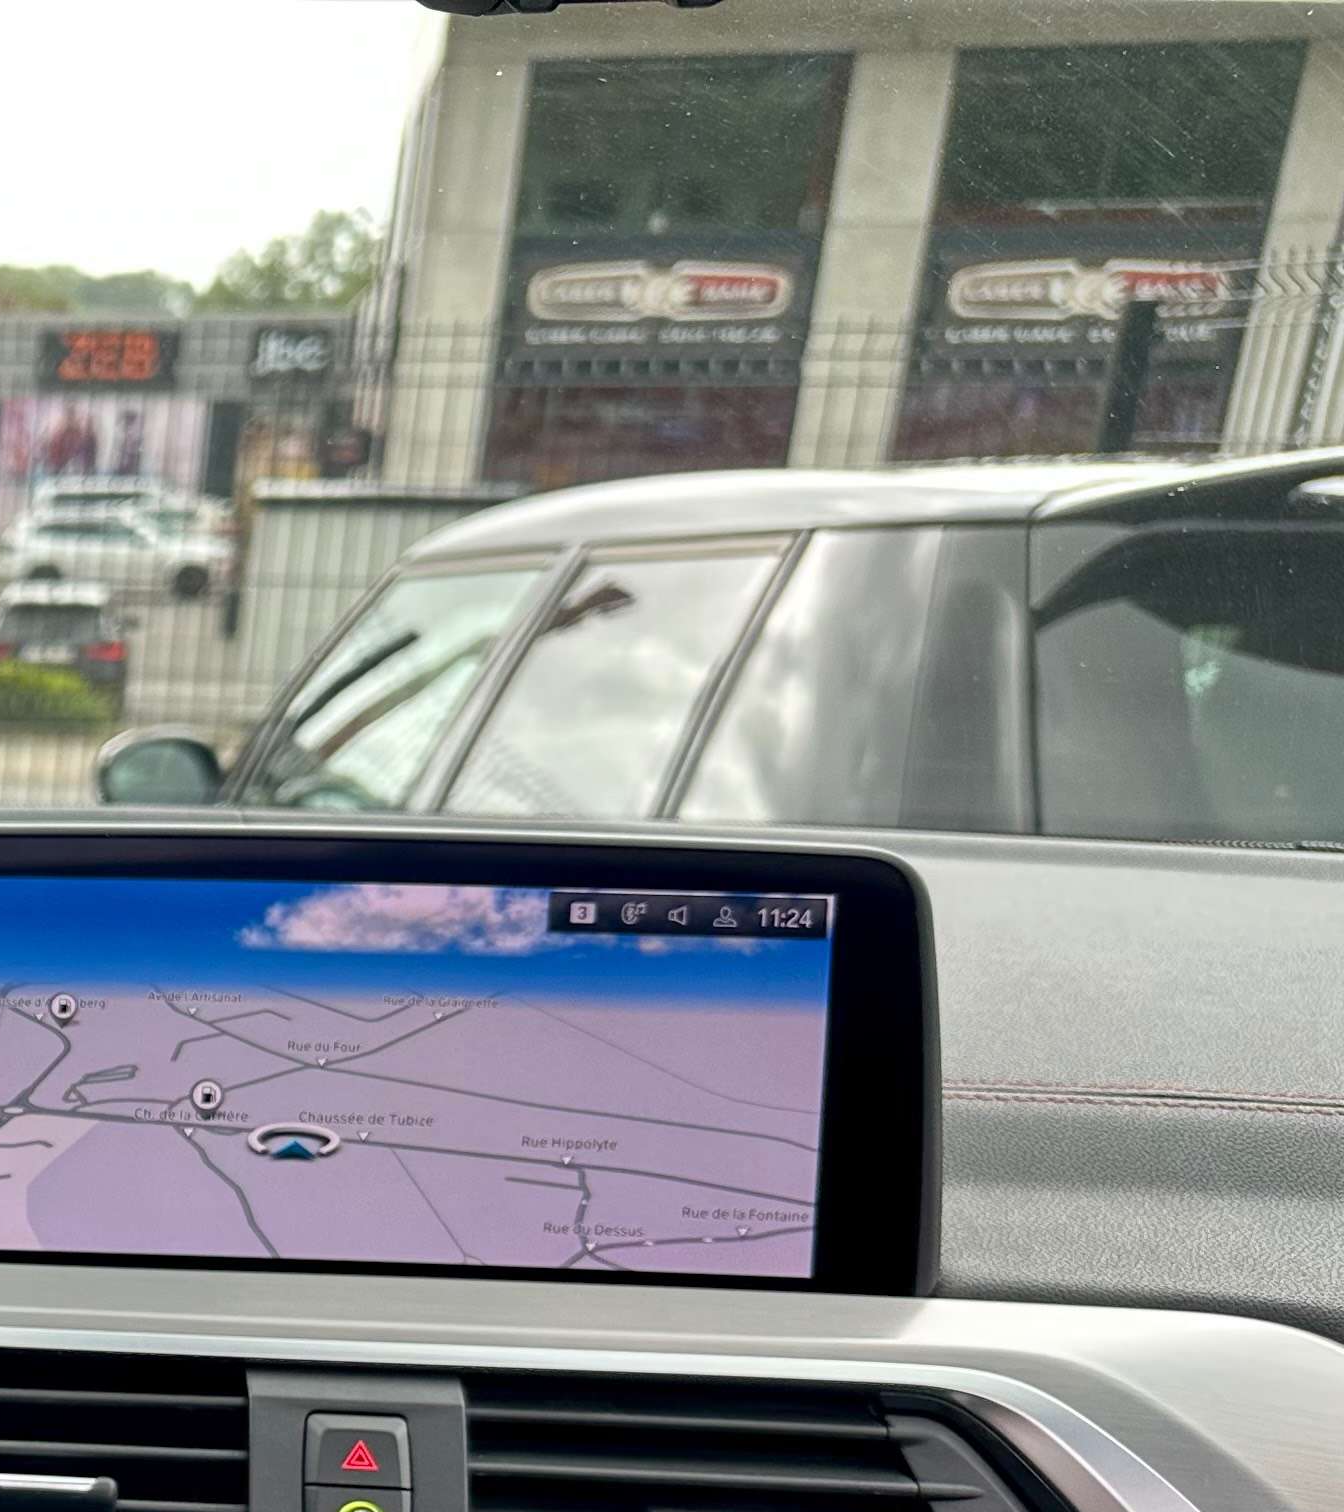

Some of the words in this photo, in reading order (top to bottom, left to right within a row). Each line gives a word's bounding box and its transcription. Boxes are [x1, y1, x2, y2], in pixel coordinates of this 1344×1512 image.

[758, 907, 814, 928] 11:24
[287, 1040, 312, 1052] Rue
[314, 1041, 331, 1053] du
[333, 1042, 362, 1053] Four
[298, 1111, 364, 1126] Chaussée
[367, 1113, 386, 1126] de
[521, 1135, 548, 1148] Rue
[551, 1137, 618, 1151] Hippolyte
[682, 1206, 708, 1219] Rue
[712, 1207, 729, 1220] de
[733, 1208, 746, 1221] la
[749, 1209, 809, 1223] Fontaine
[543, 1222, 569, 1235] Rue
[572, 1223, 591, 1236] du
[595, 1224, 645, 1237] Dessus
